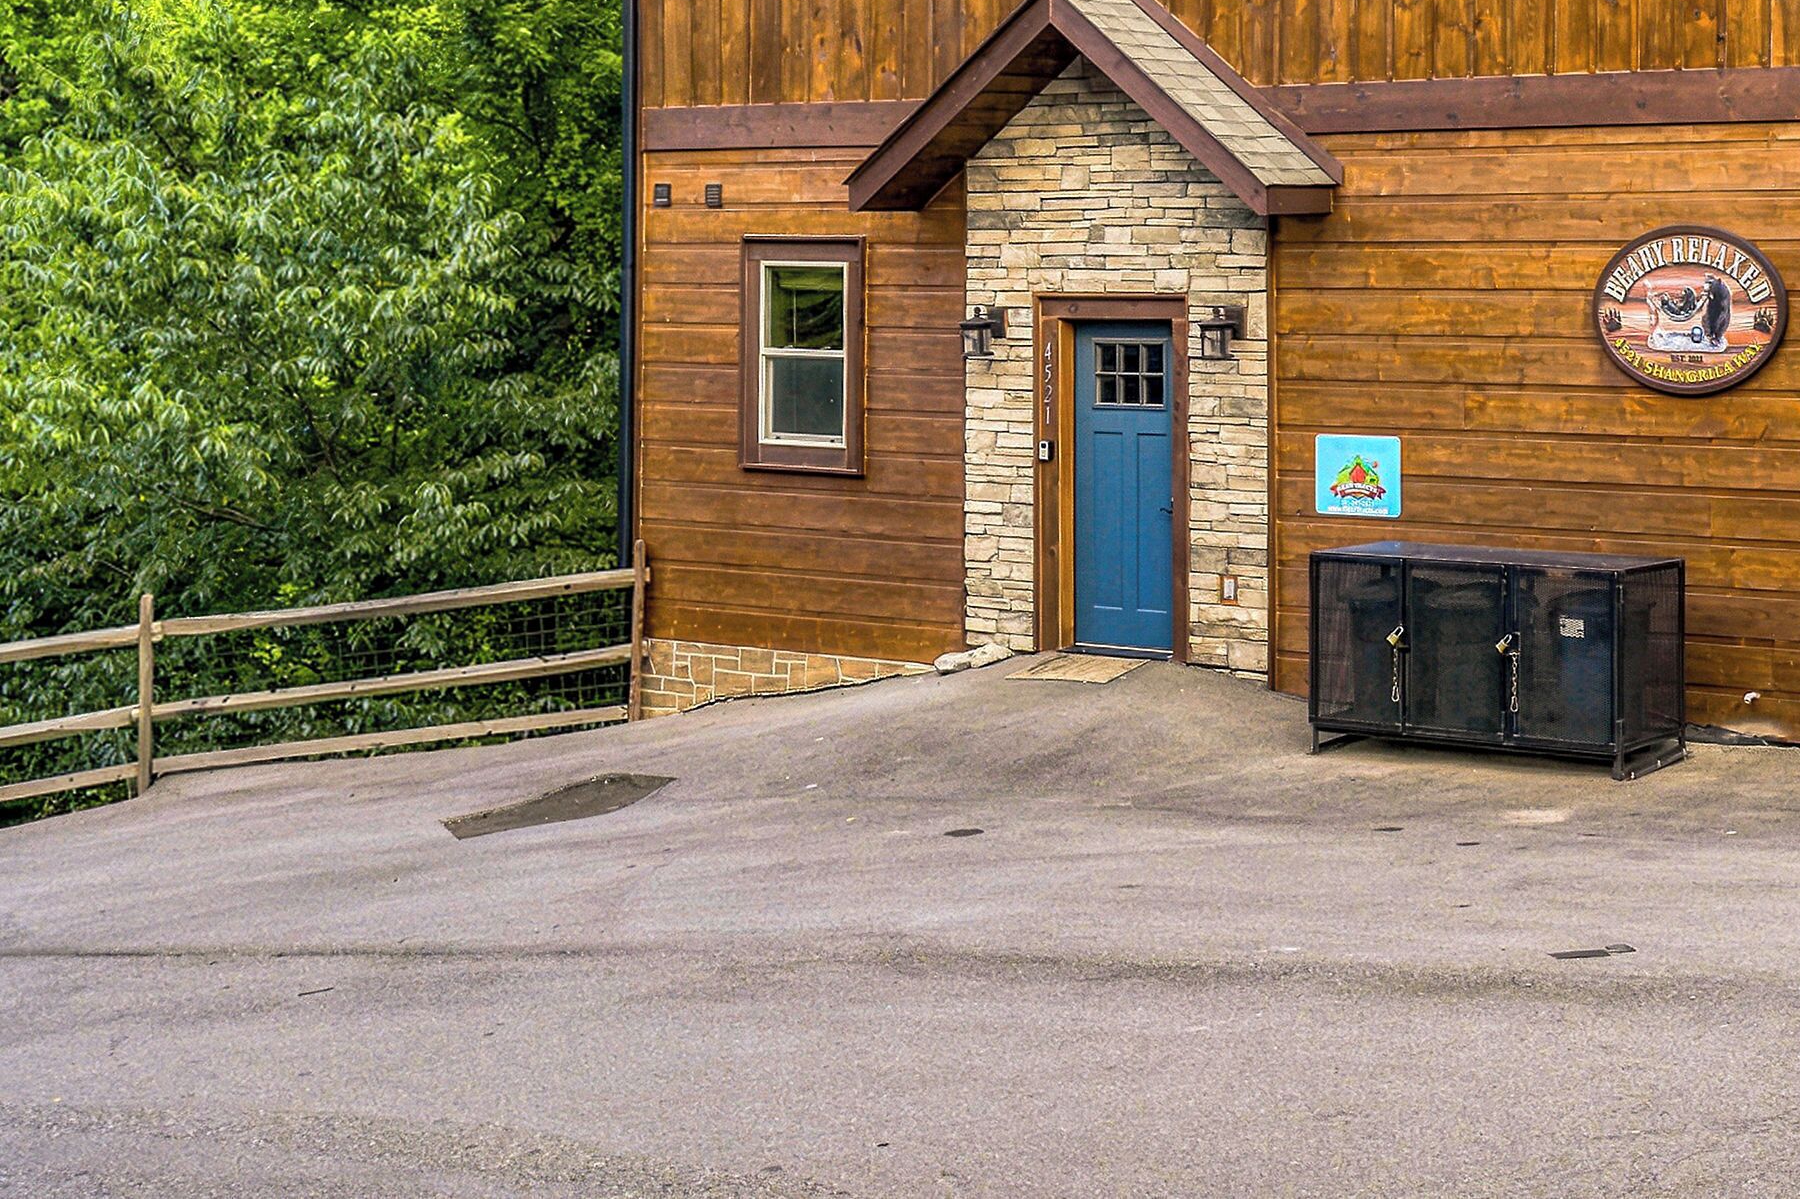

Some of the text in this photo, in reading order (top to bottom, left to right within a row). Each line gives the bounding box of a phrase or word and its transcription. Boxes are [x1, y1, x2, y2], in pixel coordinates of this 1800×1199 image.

[1603, 237, 1774, 304] BEARY RELAXED
[1043, 342, 1053, 425] 4521
[1614, 337, 1763, 384] 4521 SHANGRILA WAY
